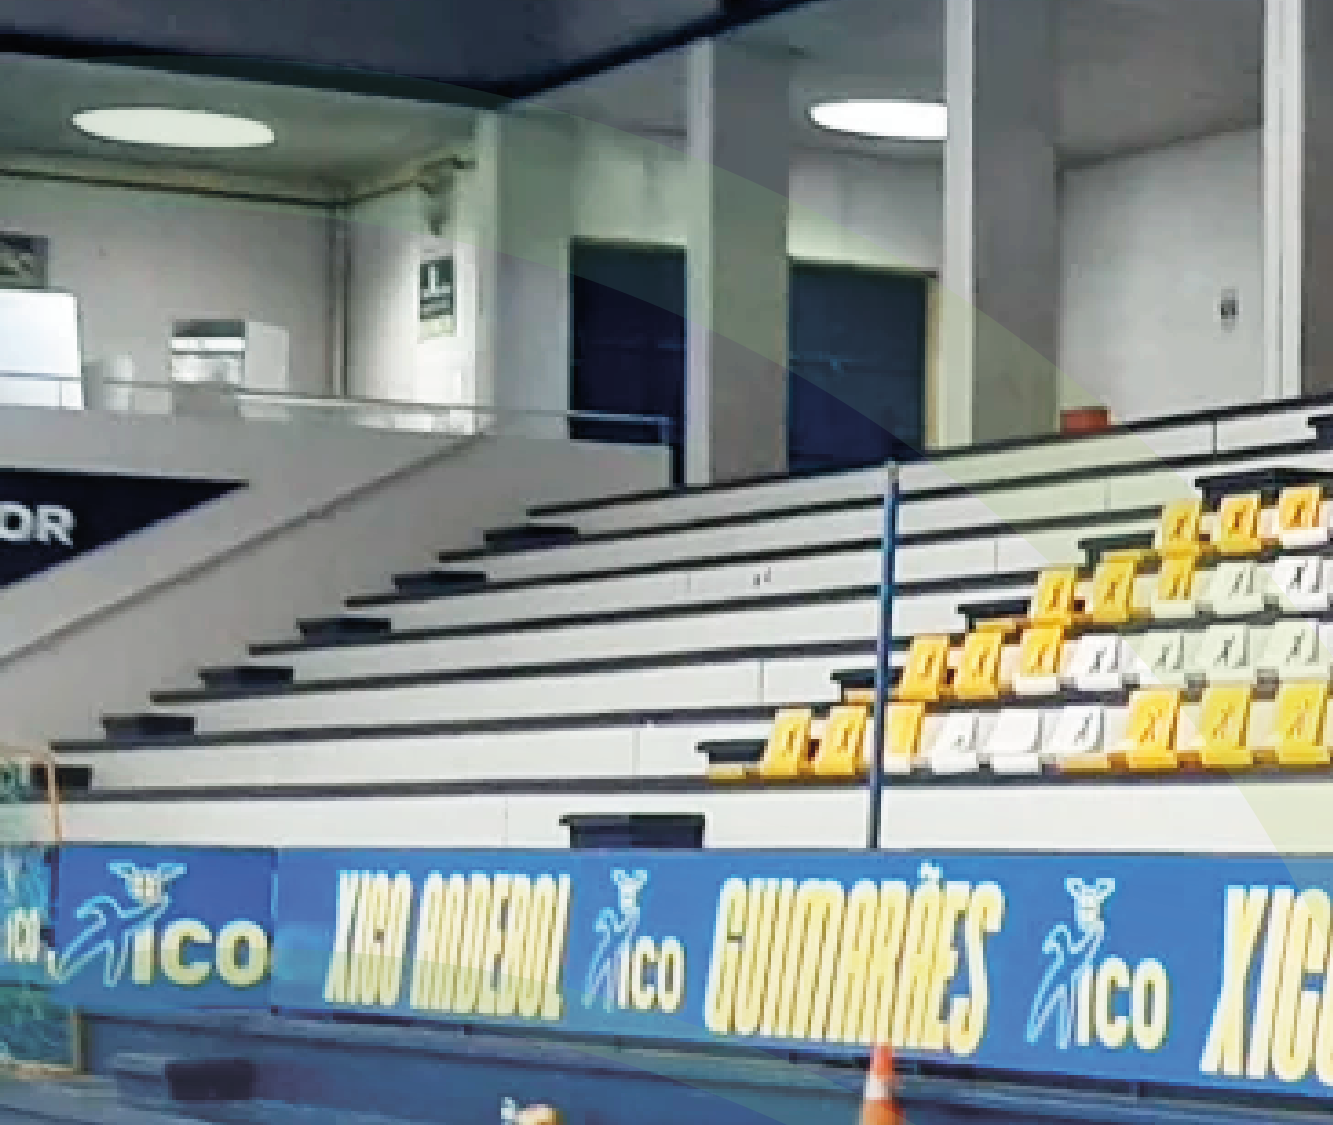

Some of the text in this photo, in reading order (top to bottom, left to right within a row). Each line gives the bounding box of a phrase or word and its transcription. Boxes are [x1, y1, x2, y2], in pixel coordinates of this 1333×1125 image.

[323, 869, 571, 1021] XICO ANDEBOL
[704, 861, 1005, 1057] GUIMARÃES
